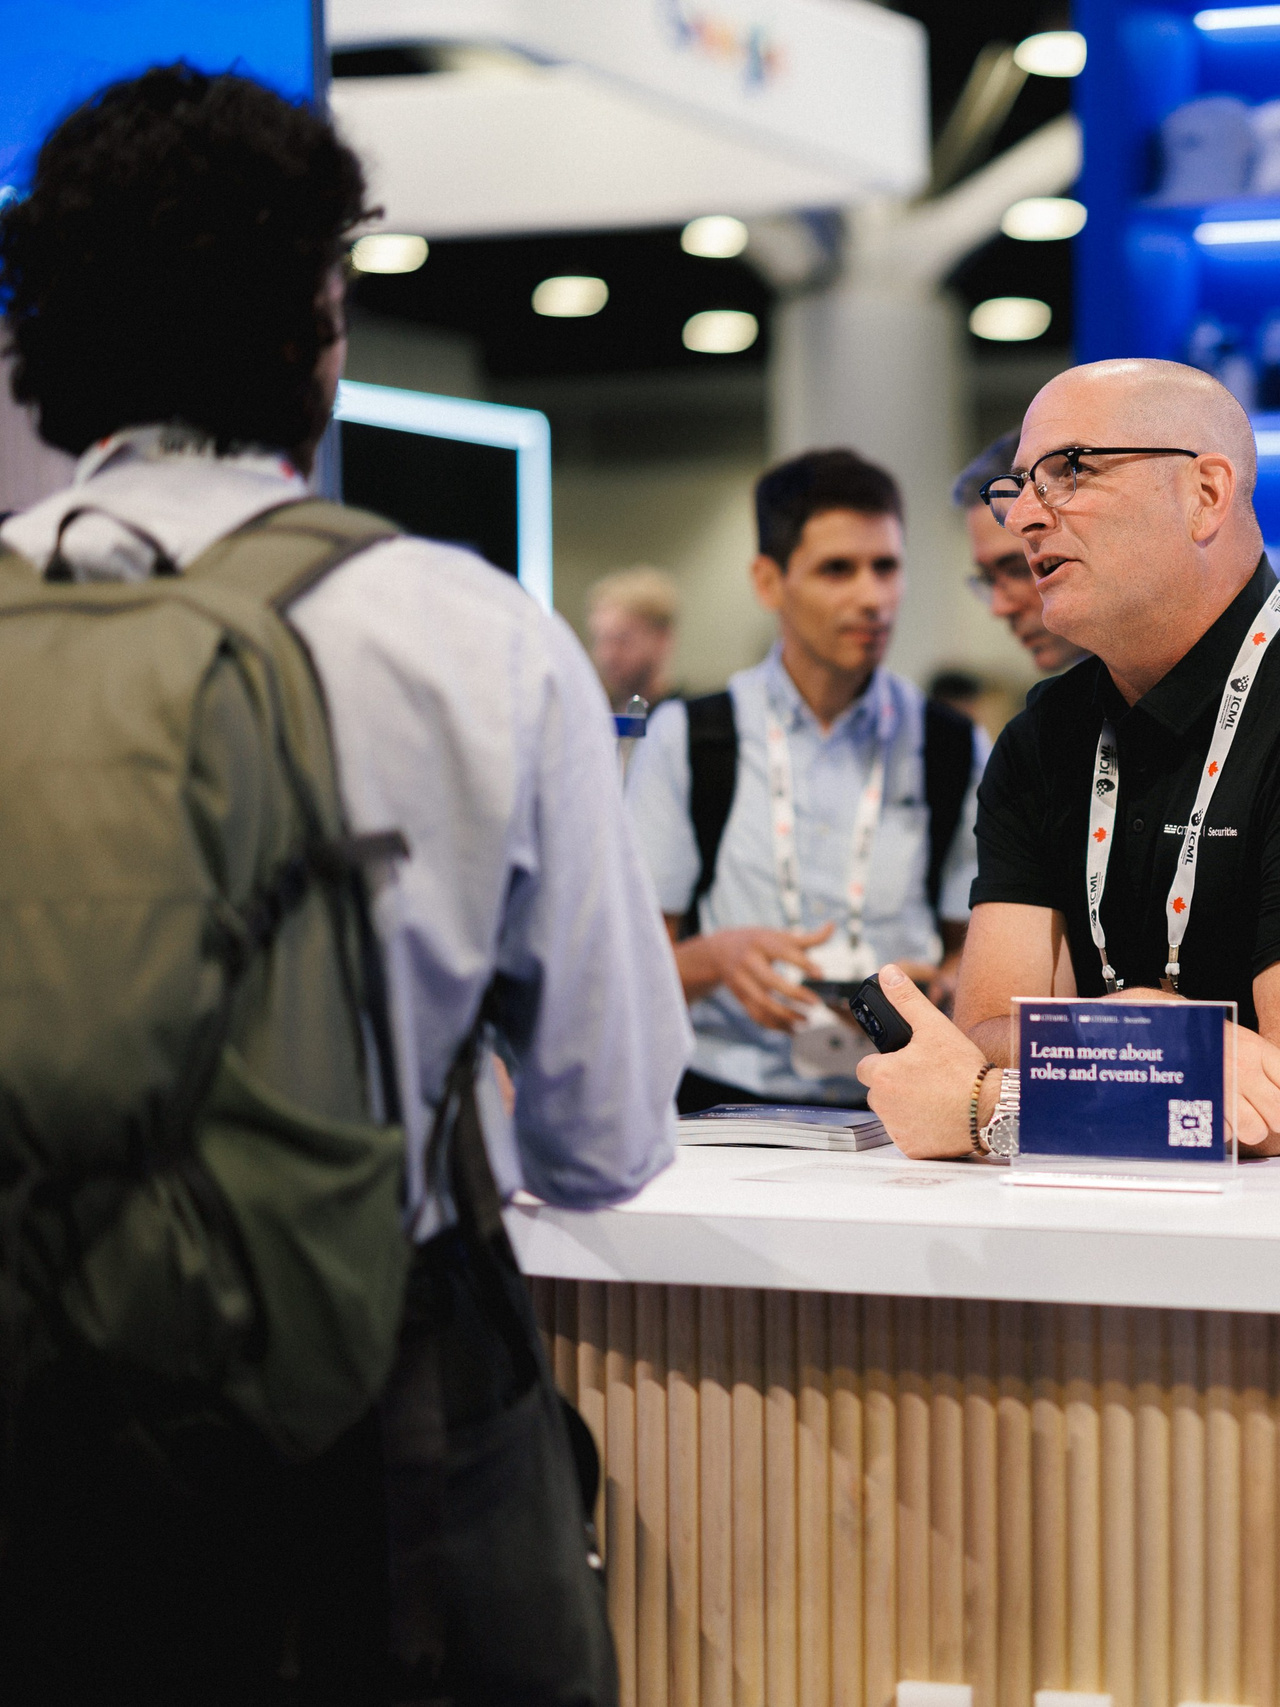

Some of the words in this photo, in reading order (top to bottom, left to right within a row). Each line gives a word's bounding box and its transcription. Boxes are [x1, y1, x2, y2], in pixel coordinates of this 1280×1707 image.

[1224, 695, 1243, 730] ICML
[1099, 744, 1111, 775] ICML
[1207, 826, 1238, 837] Securities
[1184, 831, 1197, 866] ICML
[1089, 872, 1098, 906] ICML
[1030, 1042, 1075, 1059] Learn
[1077, 1047, 1117, 1060] more
[1119, 1043, 1164, 1062] about
[1030, 1062, 1067, 1080] roles
[1068, 1064, 1097, 1081] and
[1099, 1068, 1148, 1083] events
[1150, 1065, 1184, 1084] here
